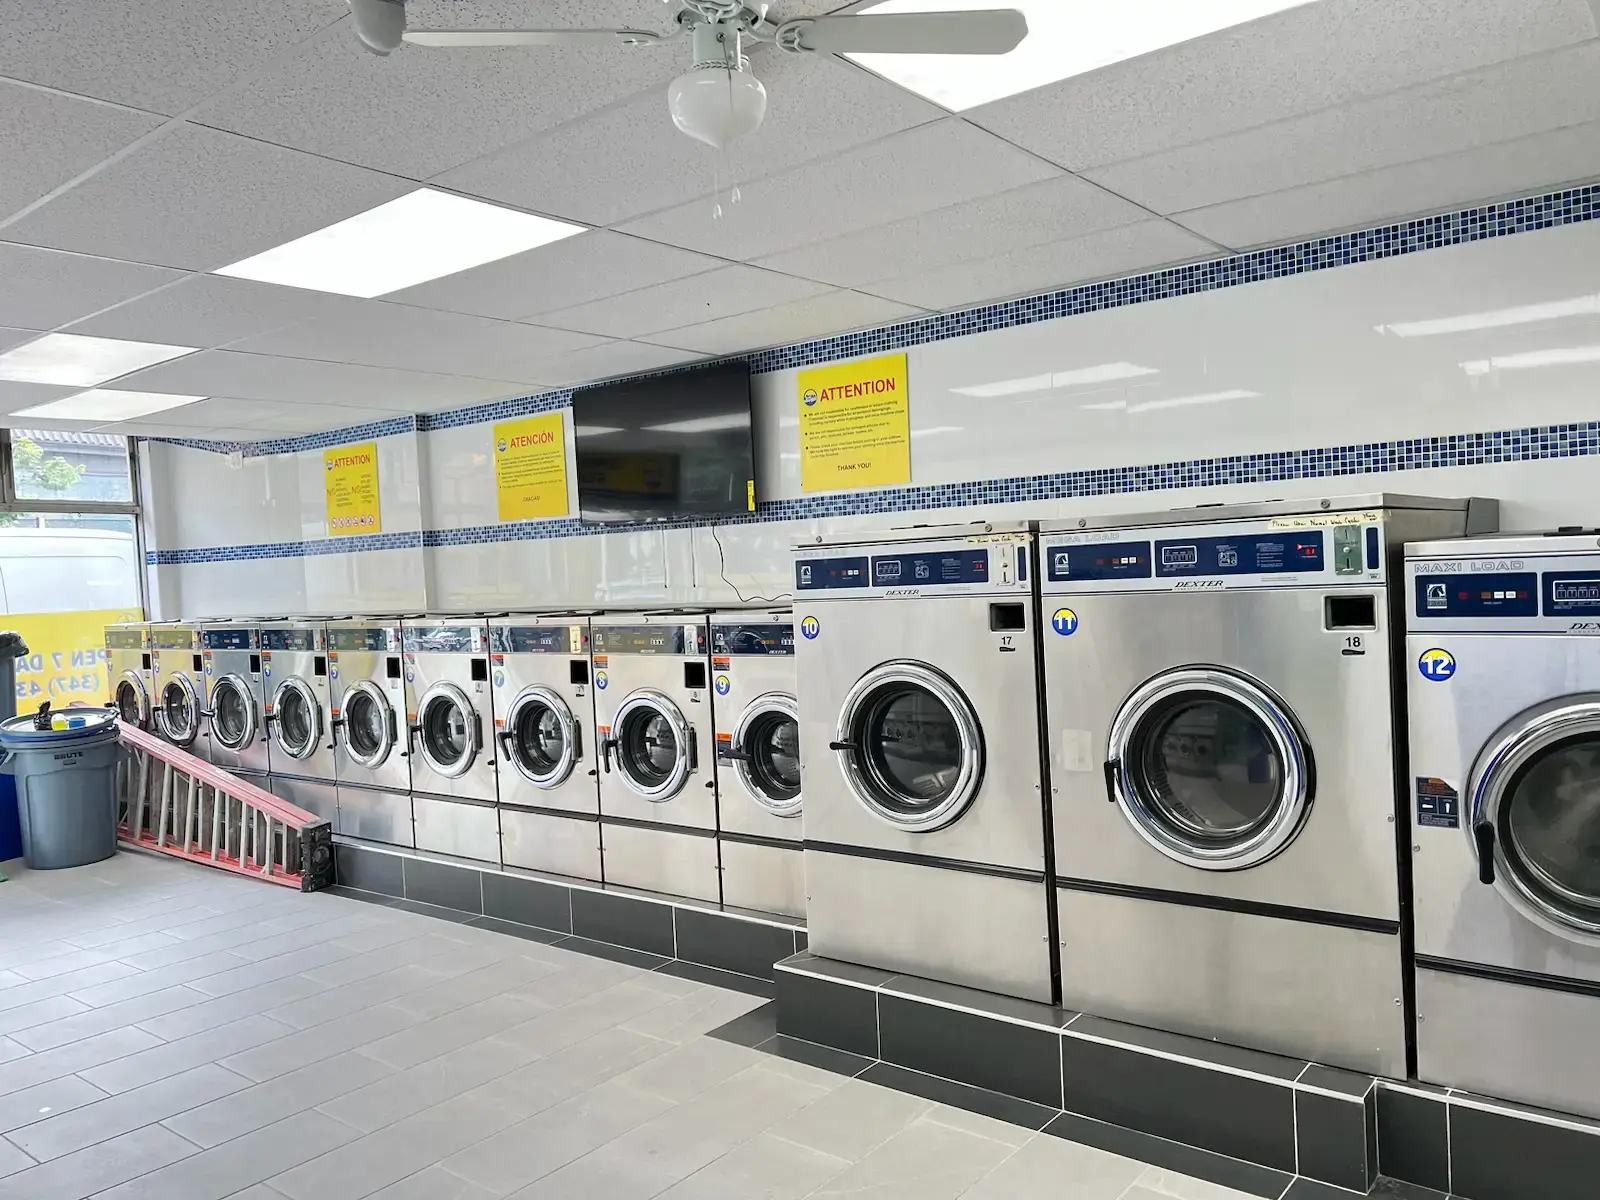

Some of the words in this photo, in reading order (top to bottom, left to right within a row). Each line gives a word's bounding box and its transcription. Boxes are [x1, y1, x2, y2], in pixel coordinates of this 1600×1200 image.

[819, 377, 896, 402] ATTENTION
[510, 430, 554, 448] ATENCIÓN
[334, 454, 371, 468] ATTENTION
[837, 461, 857, 471] THANK
[1414, 563, 1462, 573] MAXI
[1470, 560, 1524, 571] LOAD
[1175, 579, 1224, 588] DEXTER
[803, 621, 818, 635] 10
[1001, 636, 1012, 645] 17
[1345, 636, 1361, 648] 18
[1423, 655, 1451, 674] 12
